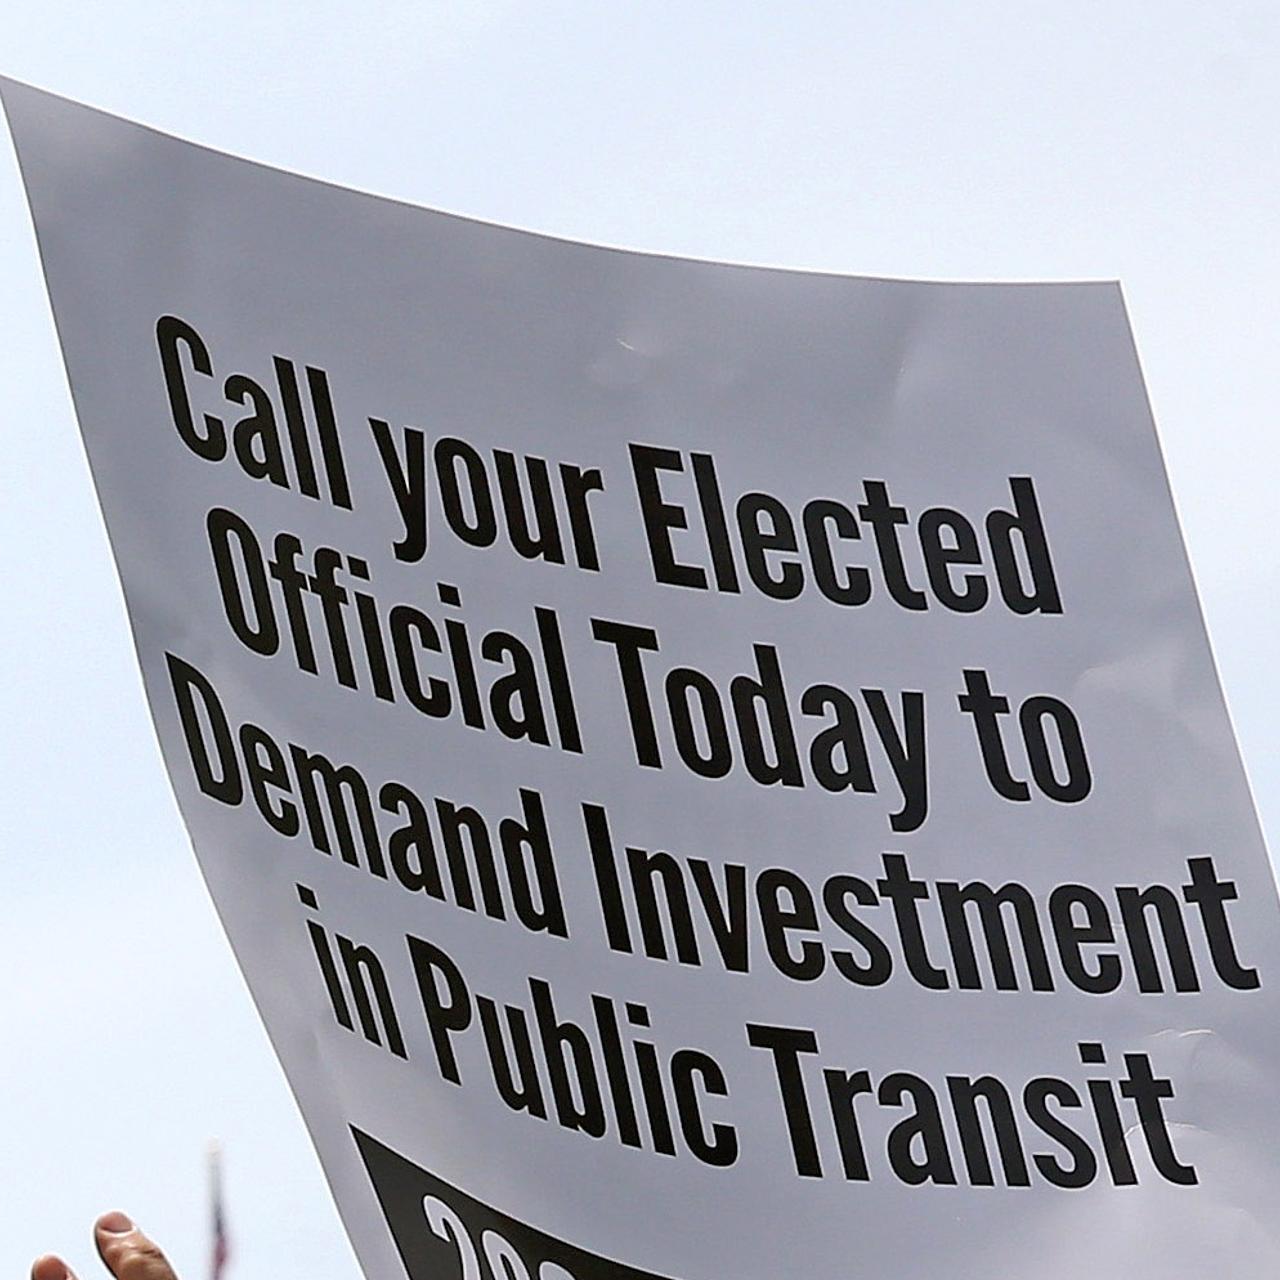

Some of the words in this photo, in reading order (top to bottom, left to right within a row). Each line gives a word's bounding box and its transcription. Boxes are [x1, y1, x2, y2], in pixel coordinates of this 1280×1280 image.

[156, 315, 354, 510] Call
[368, 415, 604, 570] your
[627, 443, 1064, 616] Elected
[166, 651, 567, 940] Demand
[583, 803, 1261, 996] Investment
[207, 508, 582, 758] Official
[592, 617, 930, 836] Today
[957, 670, 1092, 804] to
[296, 884, 407, 1062] in
[405, 948, 738, 1170] Public
[746, 1021, 1197, 1191] Transit
